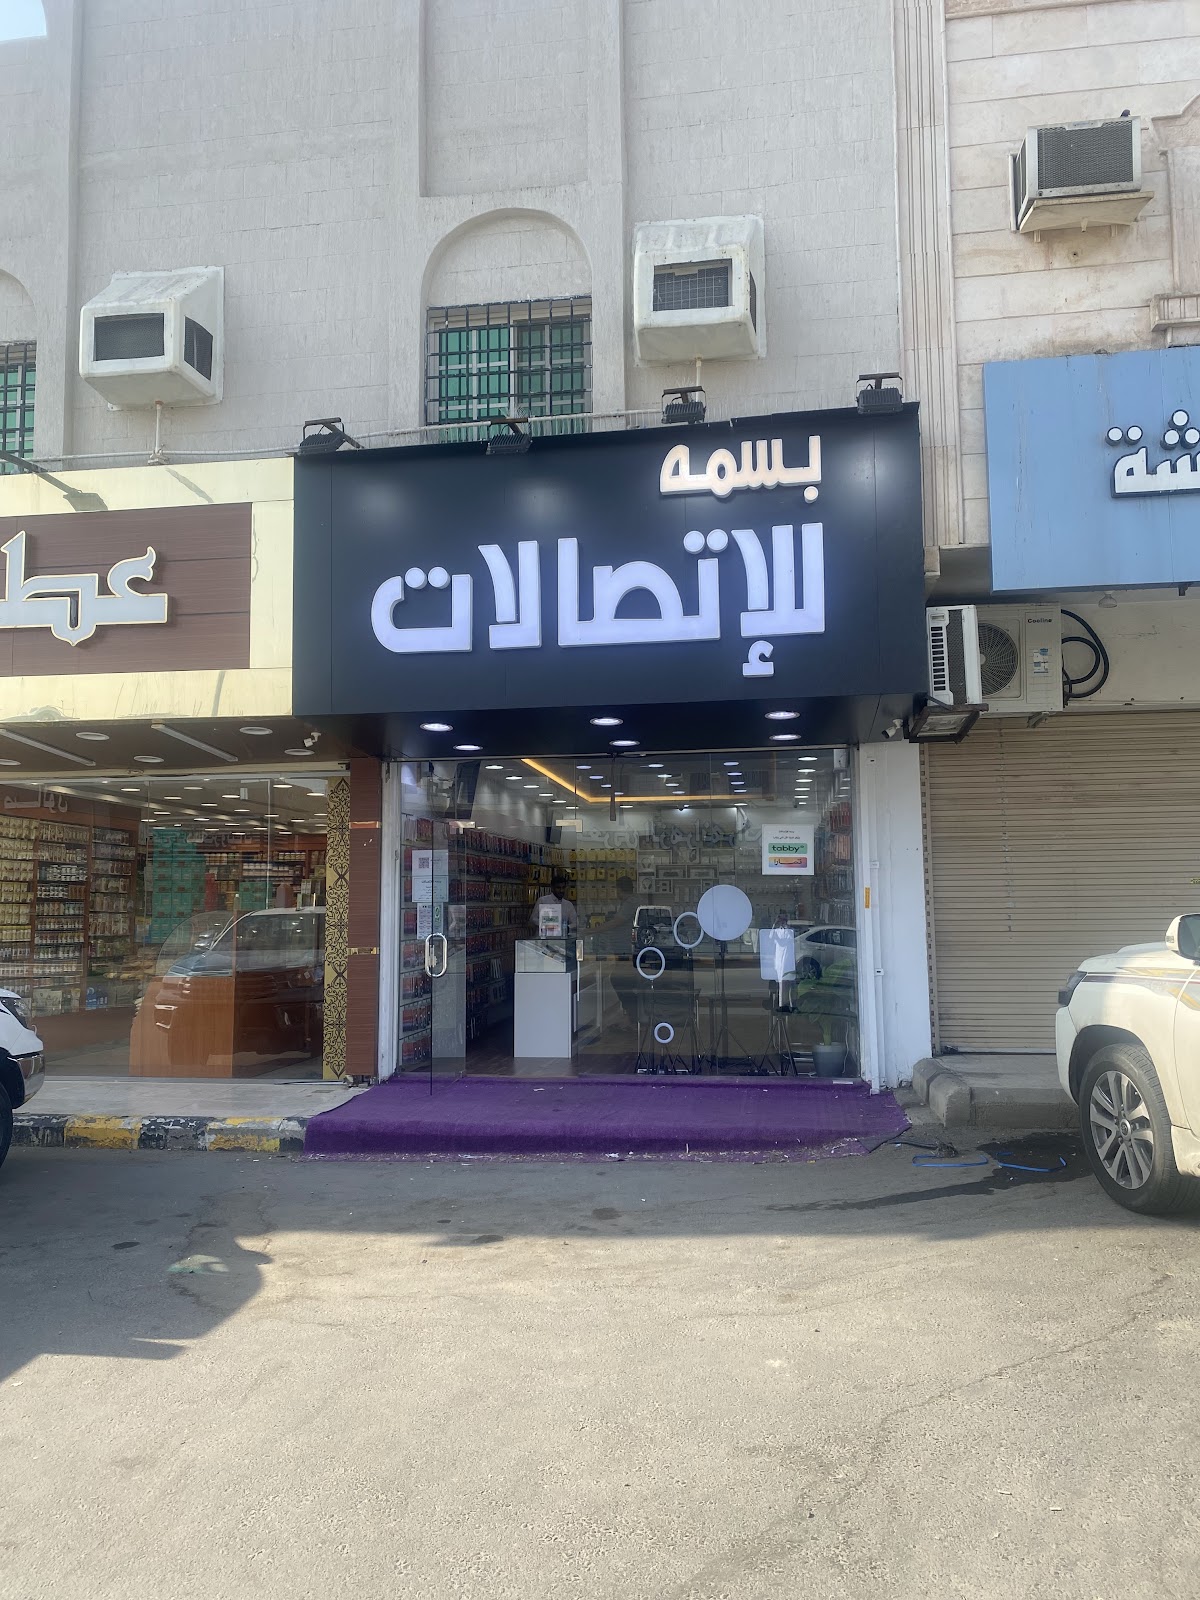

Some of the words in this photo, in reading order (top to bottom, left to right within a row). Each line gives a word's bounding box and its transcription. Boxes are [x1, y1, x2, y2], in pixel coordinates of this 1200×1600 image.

[660, 435, 822, 504] بسمه
[370, 522, 826, 678] للإتصالات
[771, 845, 800, 853] tabby
